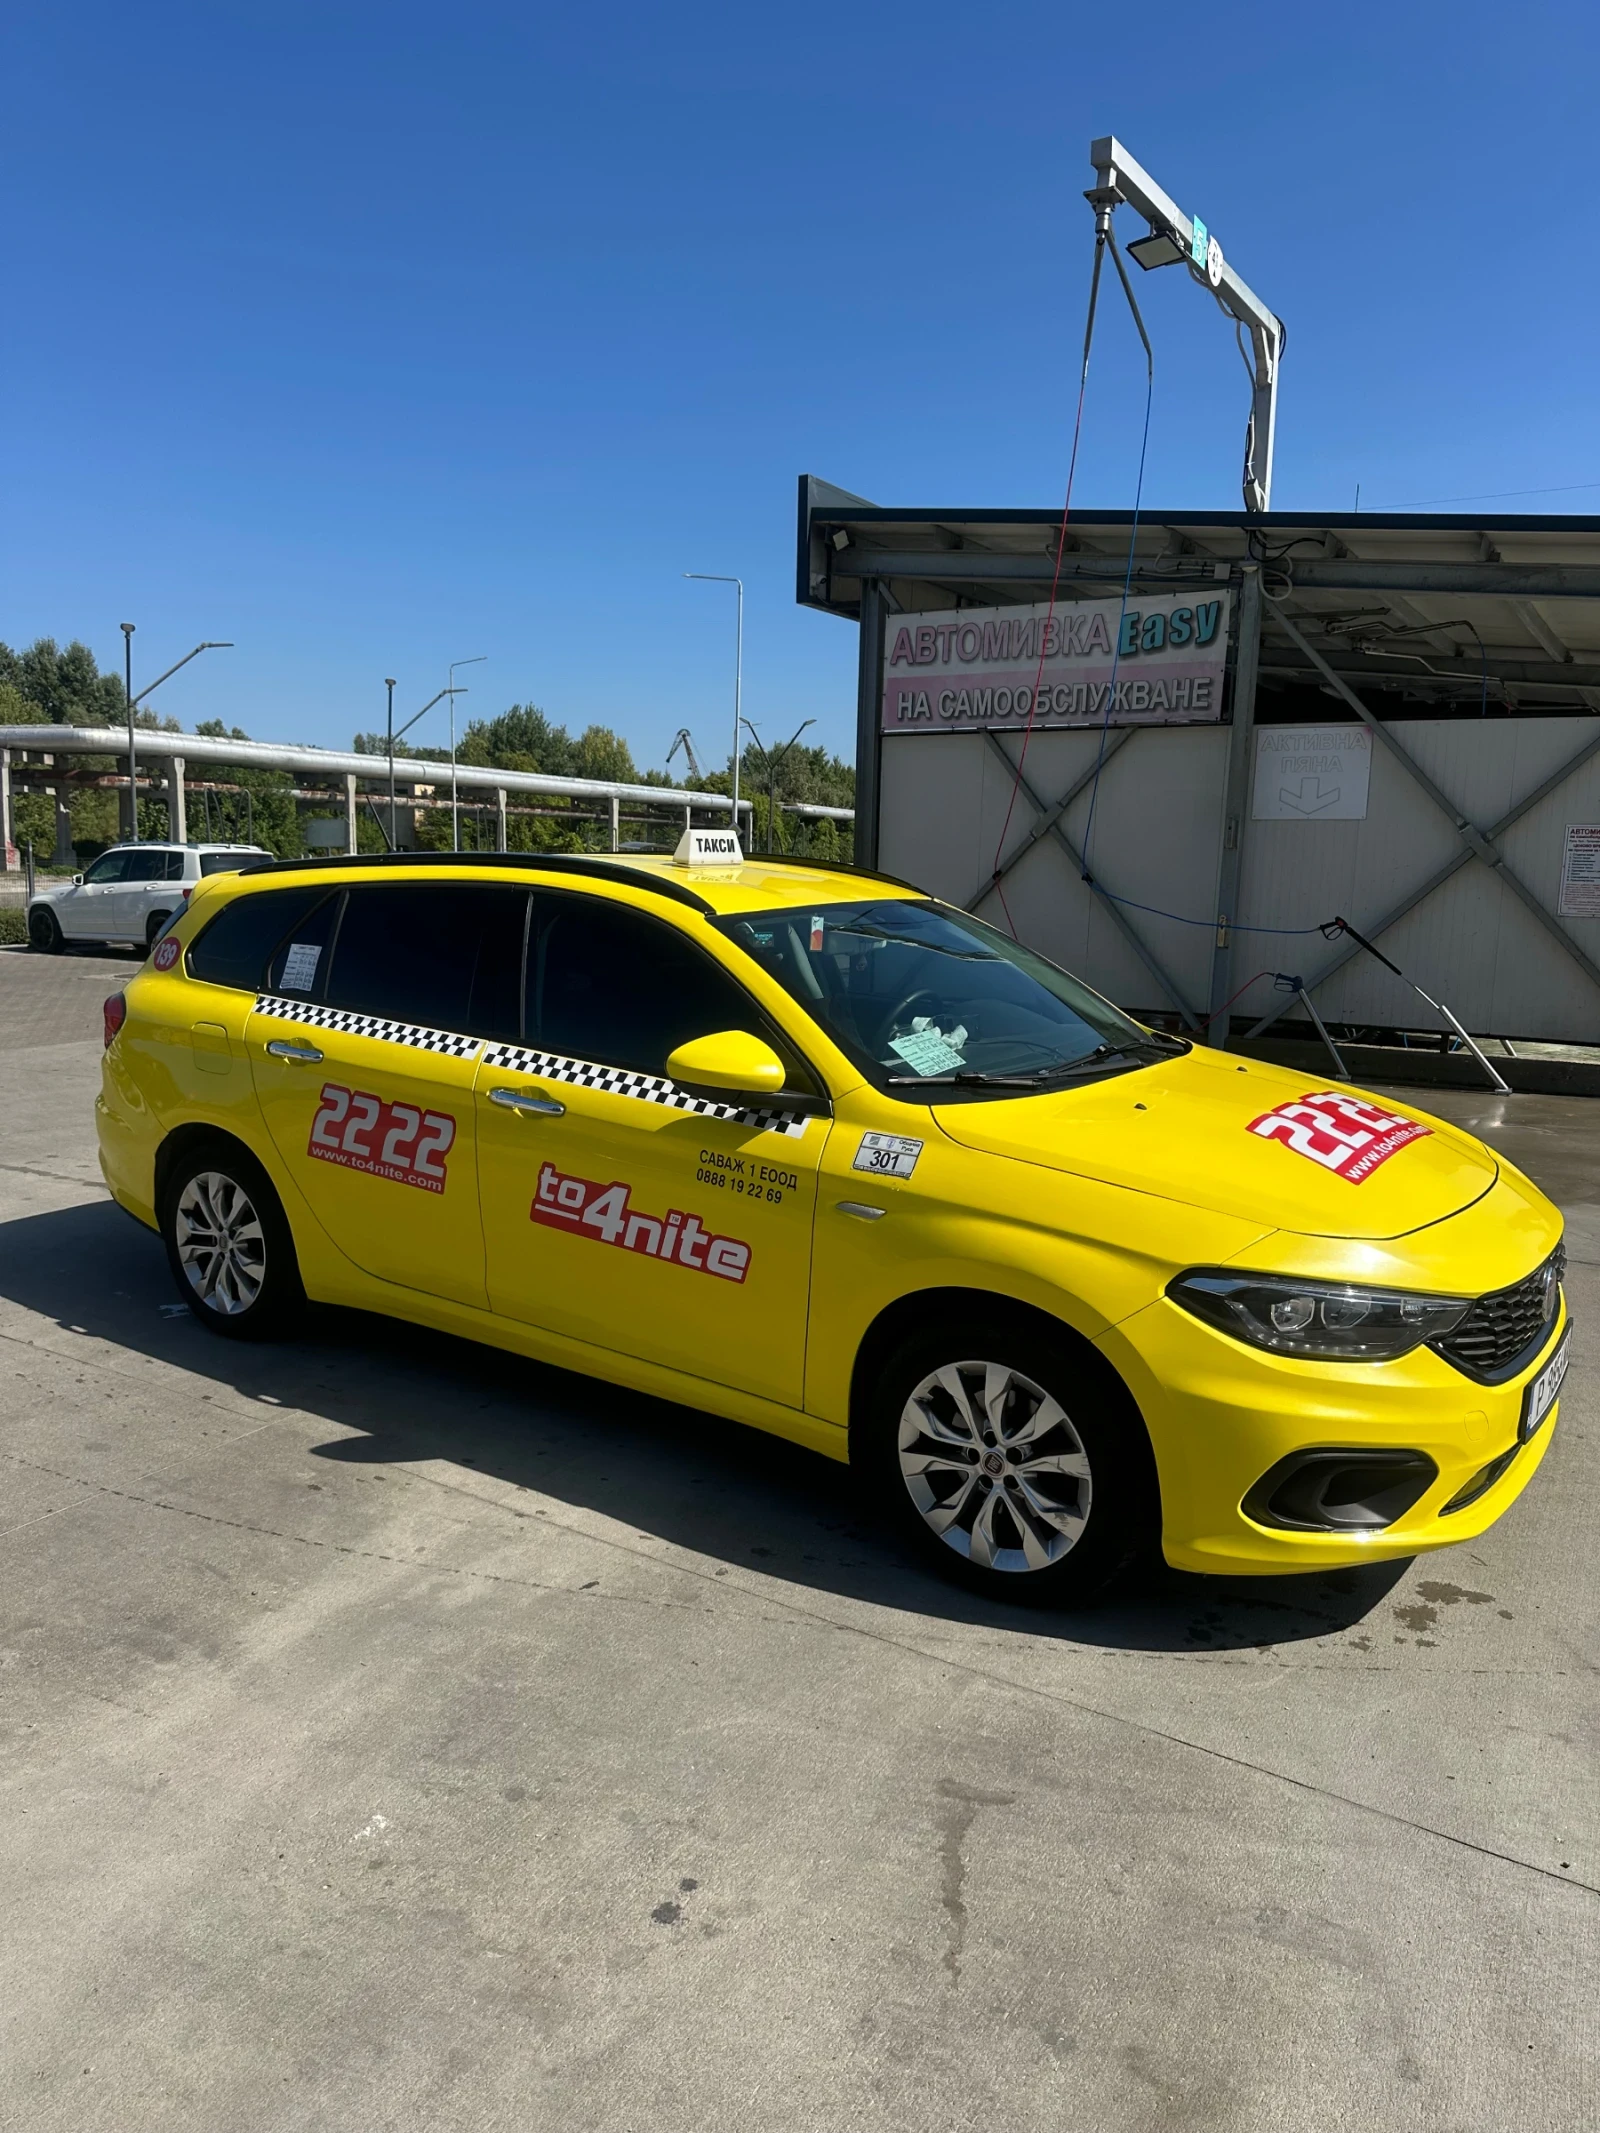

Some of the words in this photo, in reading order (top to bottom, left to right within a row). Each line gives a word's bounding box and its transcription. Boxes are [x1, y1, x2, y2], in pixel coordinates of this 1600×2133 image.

[890, 614, 1111, 665] АВТОМИВКА
[1119, 600, 1220, 656] Easy
[897, 690, 931, 719] НА
[938, 677, 1211, 717] САМООБСЛУЖВАНЕ
[1260, 732, 1367, 752] АКТИВНА
[1281, 755, 1343, 774] ПЯНА
[696, 838, 736, 853] ТАКСИ
[157, 943, 178, 967] 139
[312, 1147, 442, 1192] www.to4nite.com
[700, 1149, 745, 1174] САВАЖ
[749, 1163, 756, 1177] 1
[760, 1166, 798, 1191] ЕООД
[869, 1150, 900, 1170] 301
[1345, 1125, 1430, 1179] www.to4nite.com
[696, 1168, 726, 1188] 0888
[730, 1178, 744, 1193] 19
[747, 1183, 763, 1199] 22
[766, 1188, 782, 1204] 69
[540, 1167, 749, 1280] to4nite
